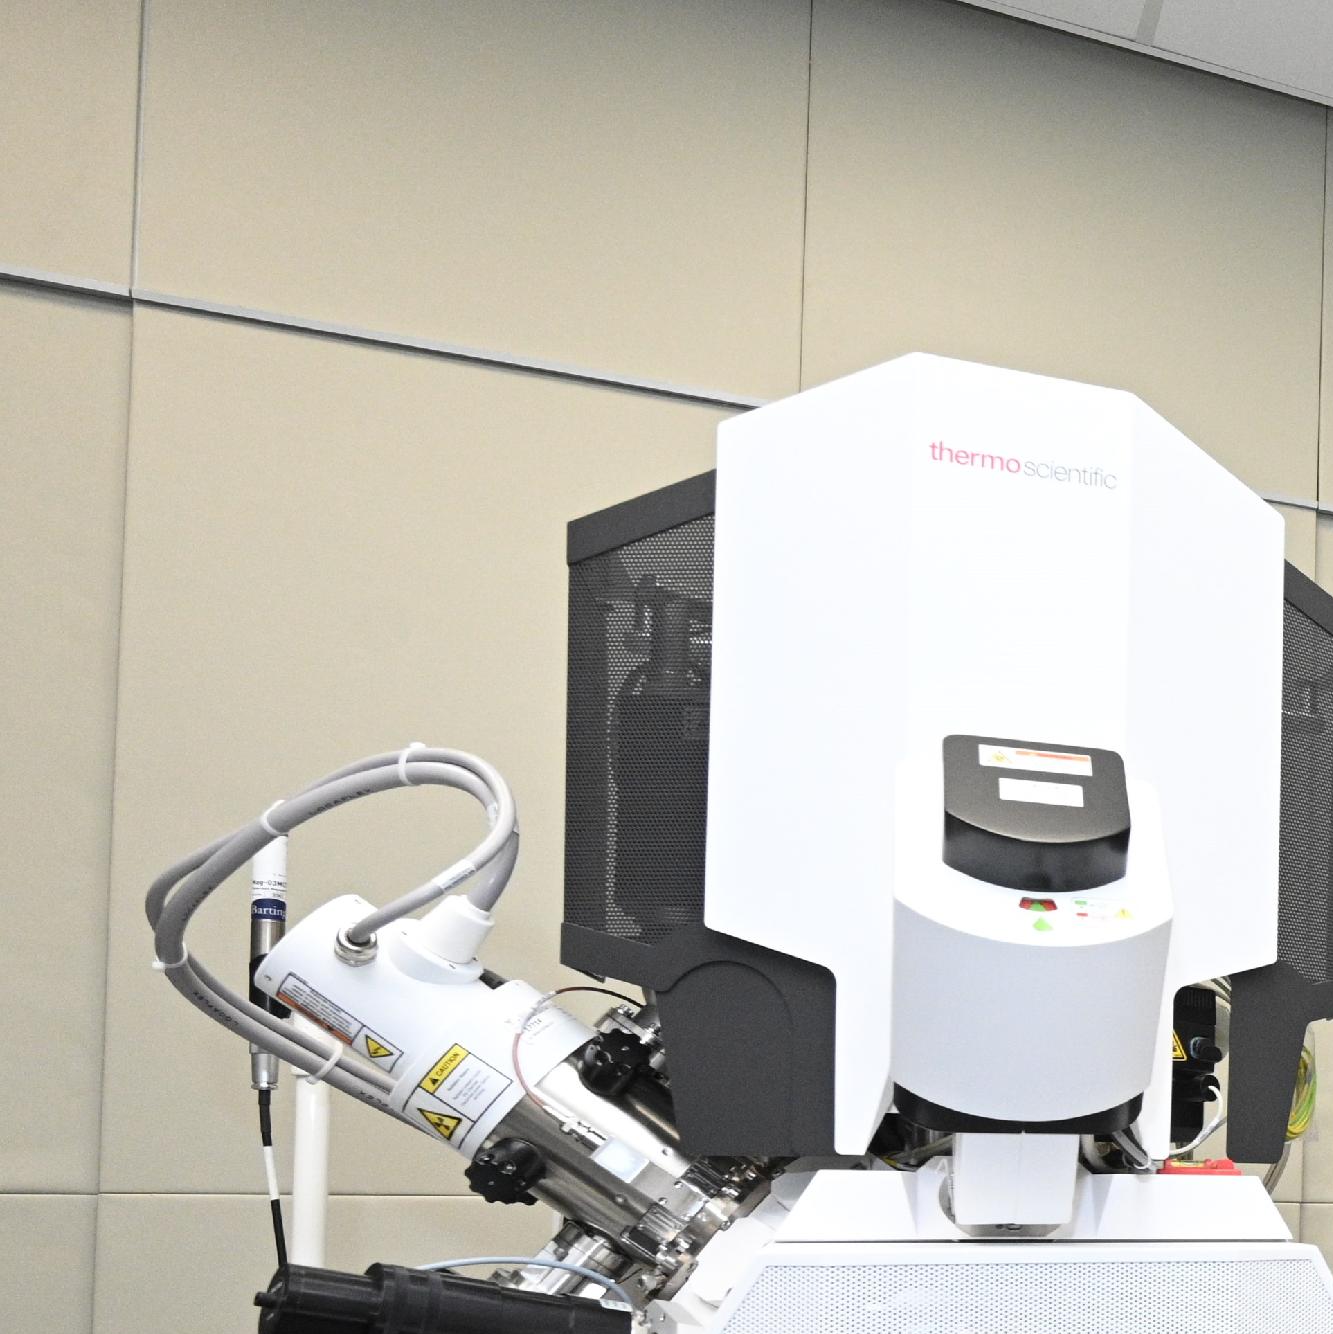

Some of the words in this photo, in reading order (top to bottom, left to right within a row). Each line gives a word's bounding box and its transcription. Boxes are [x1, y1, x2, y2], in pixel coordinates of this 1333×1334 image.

[929, 440, 1021, 474] thermo
[1023, 460, 1118, 491] scientific
[436, 1051, 461, 1077] CAUTION
